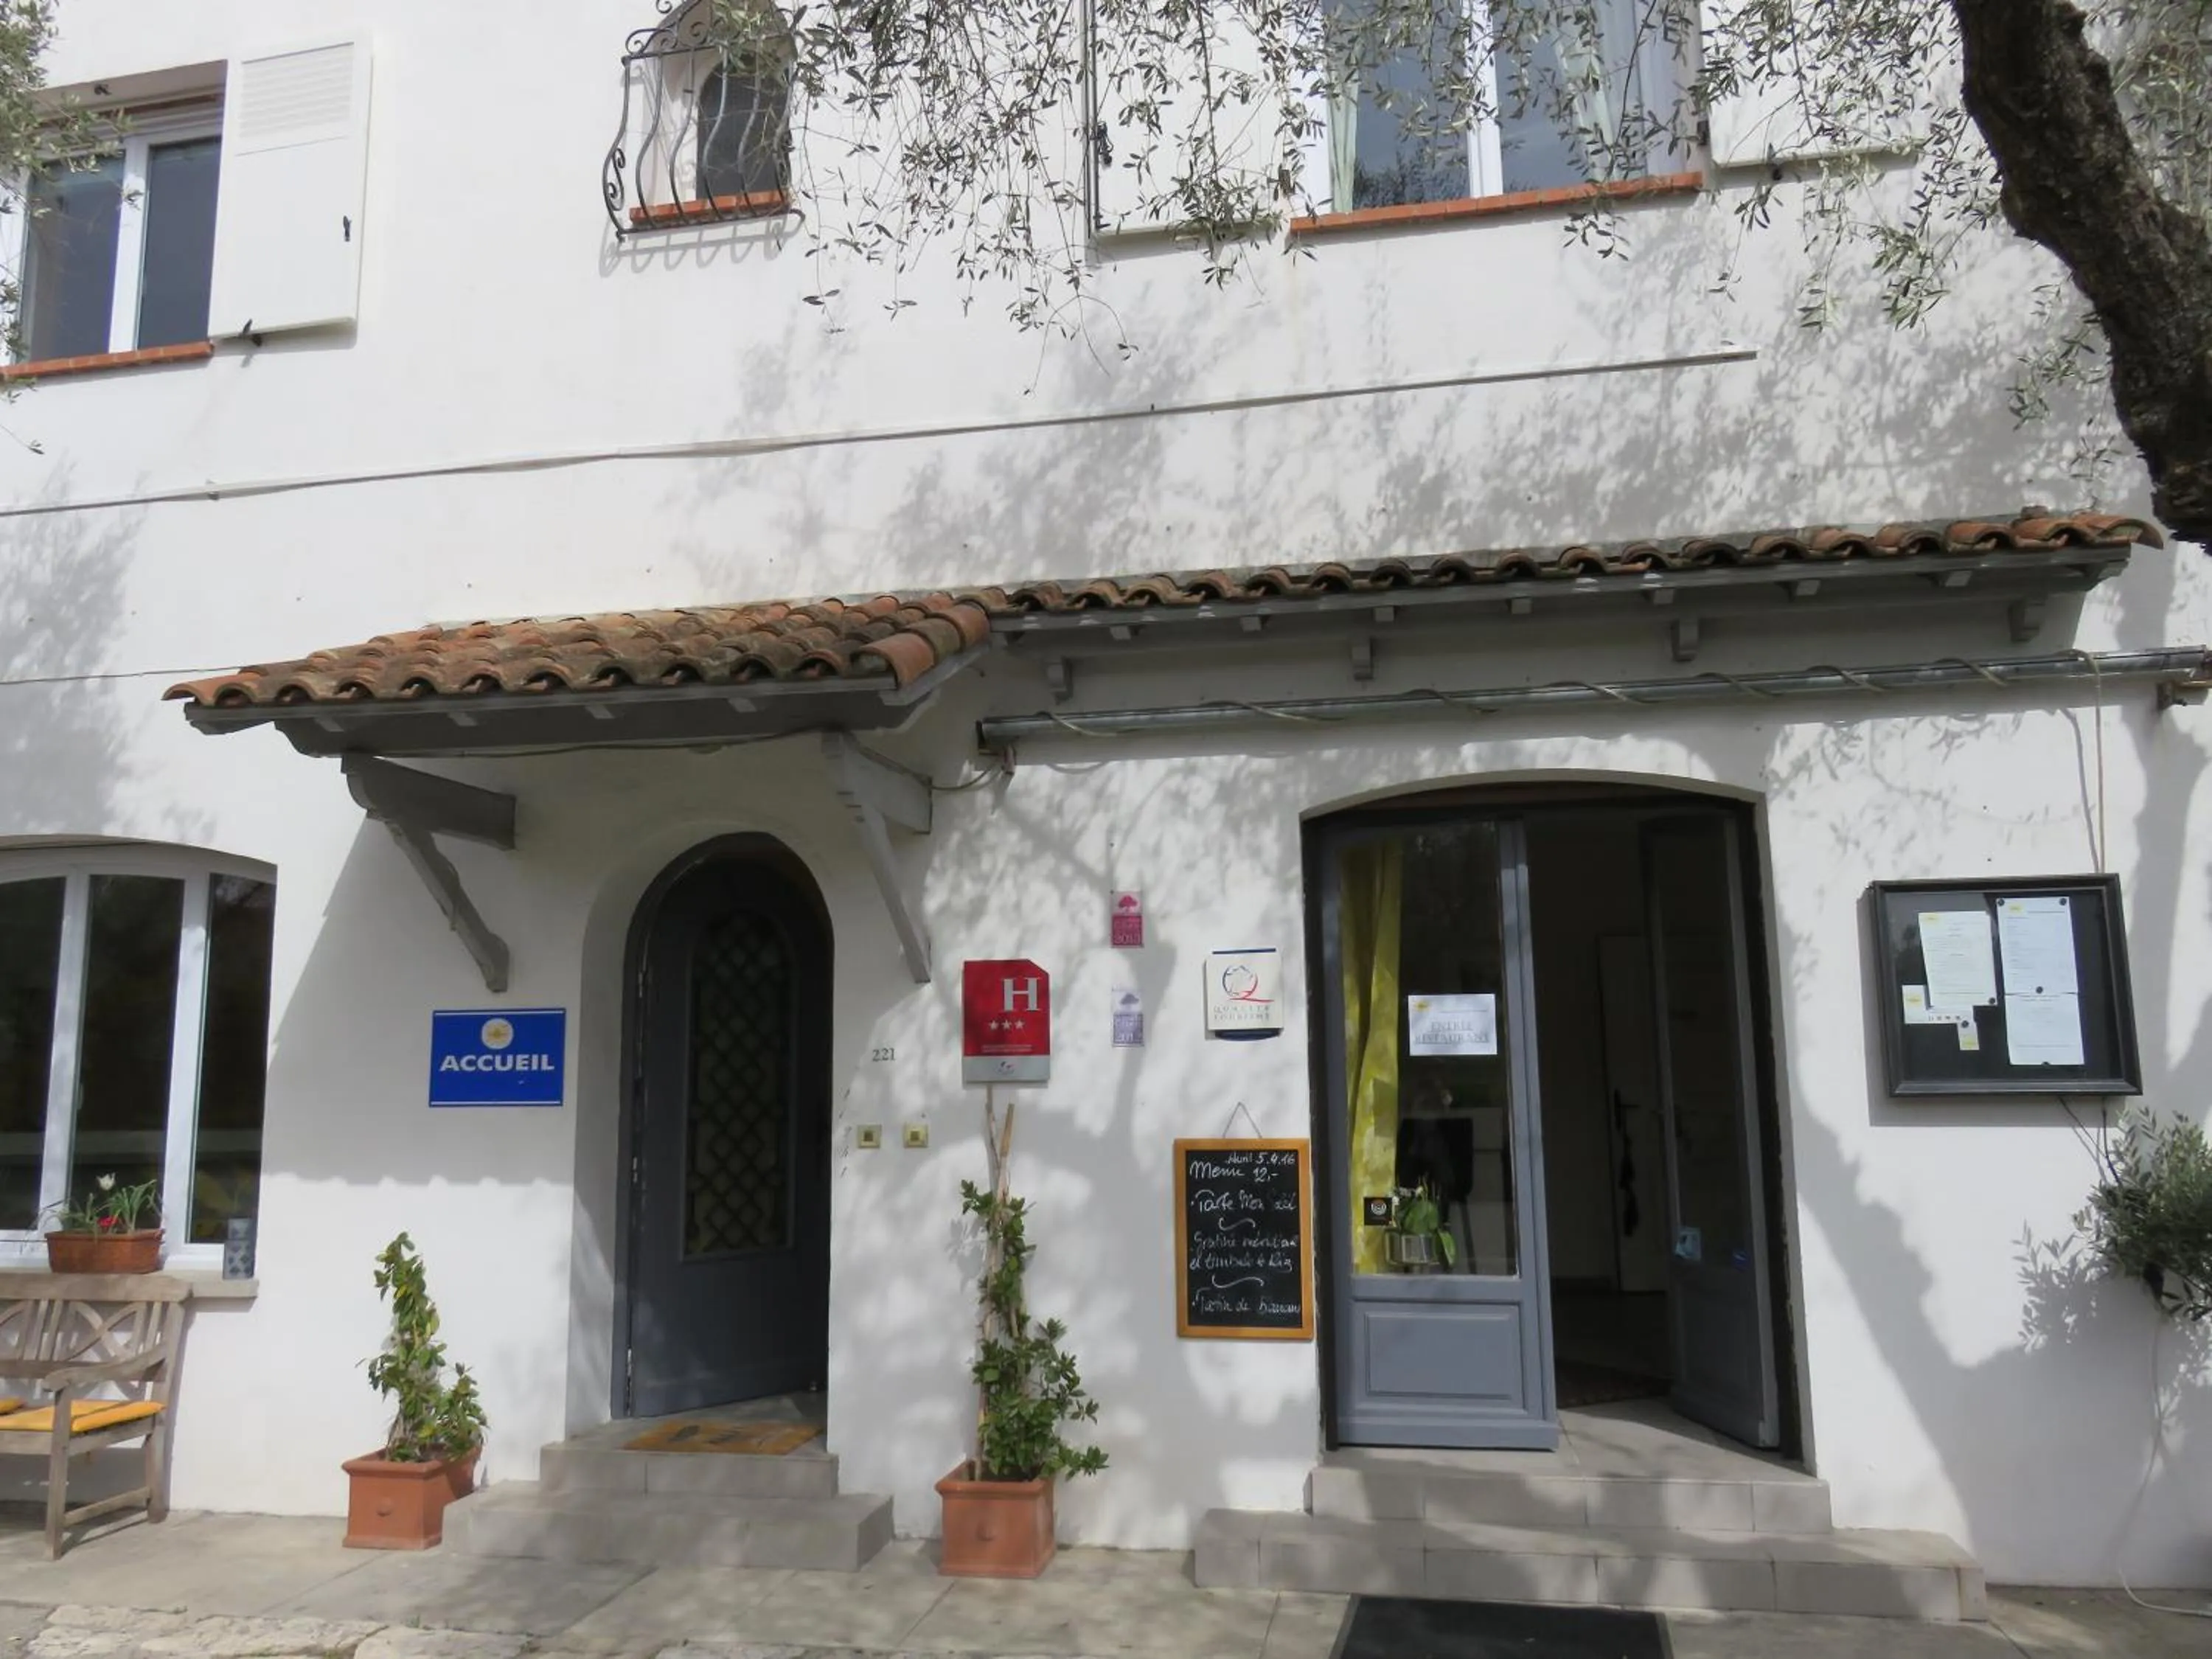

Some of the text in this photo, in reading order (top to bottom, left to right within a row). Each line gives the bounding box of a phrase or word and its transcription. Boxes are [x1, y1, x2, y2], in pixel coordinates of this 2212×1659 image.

[1002, 976, 1040, 1011] H
[439, 1054, 555, 1071] ACCUEIL
[1189, 1160, 1245, 1179] Menu
